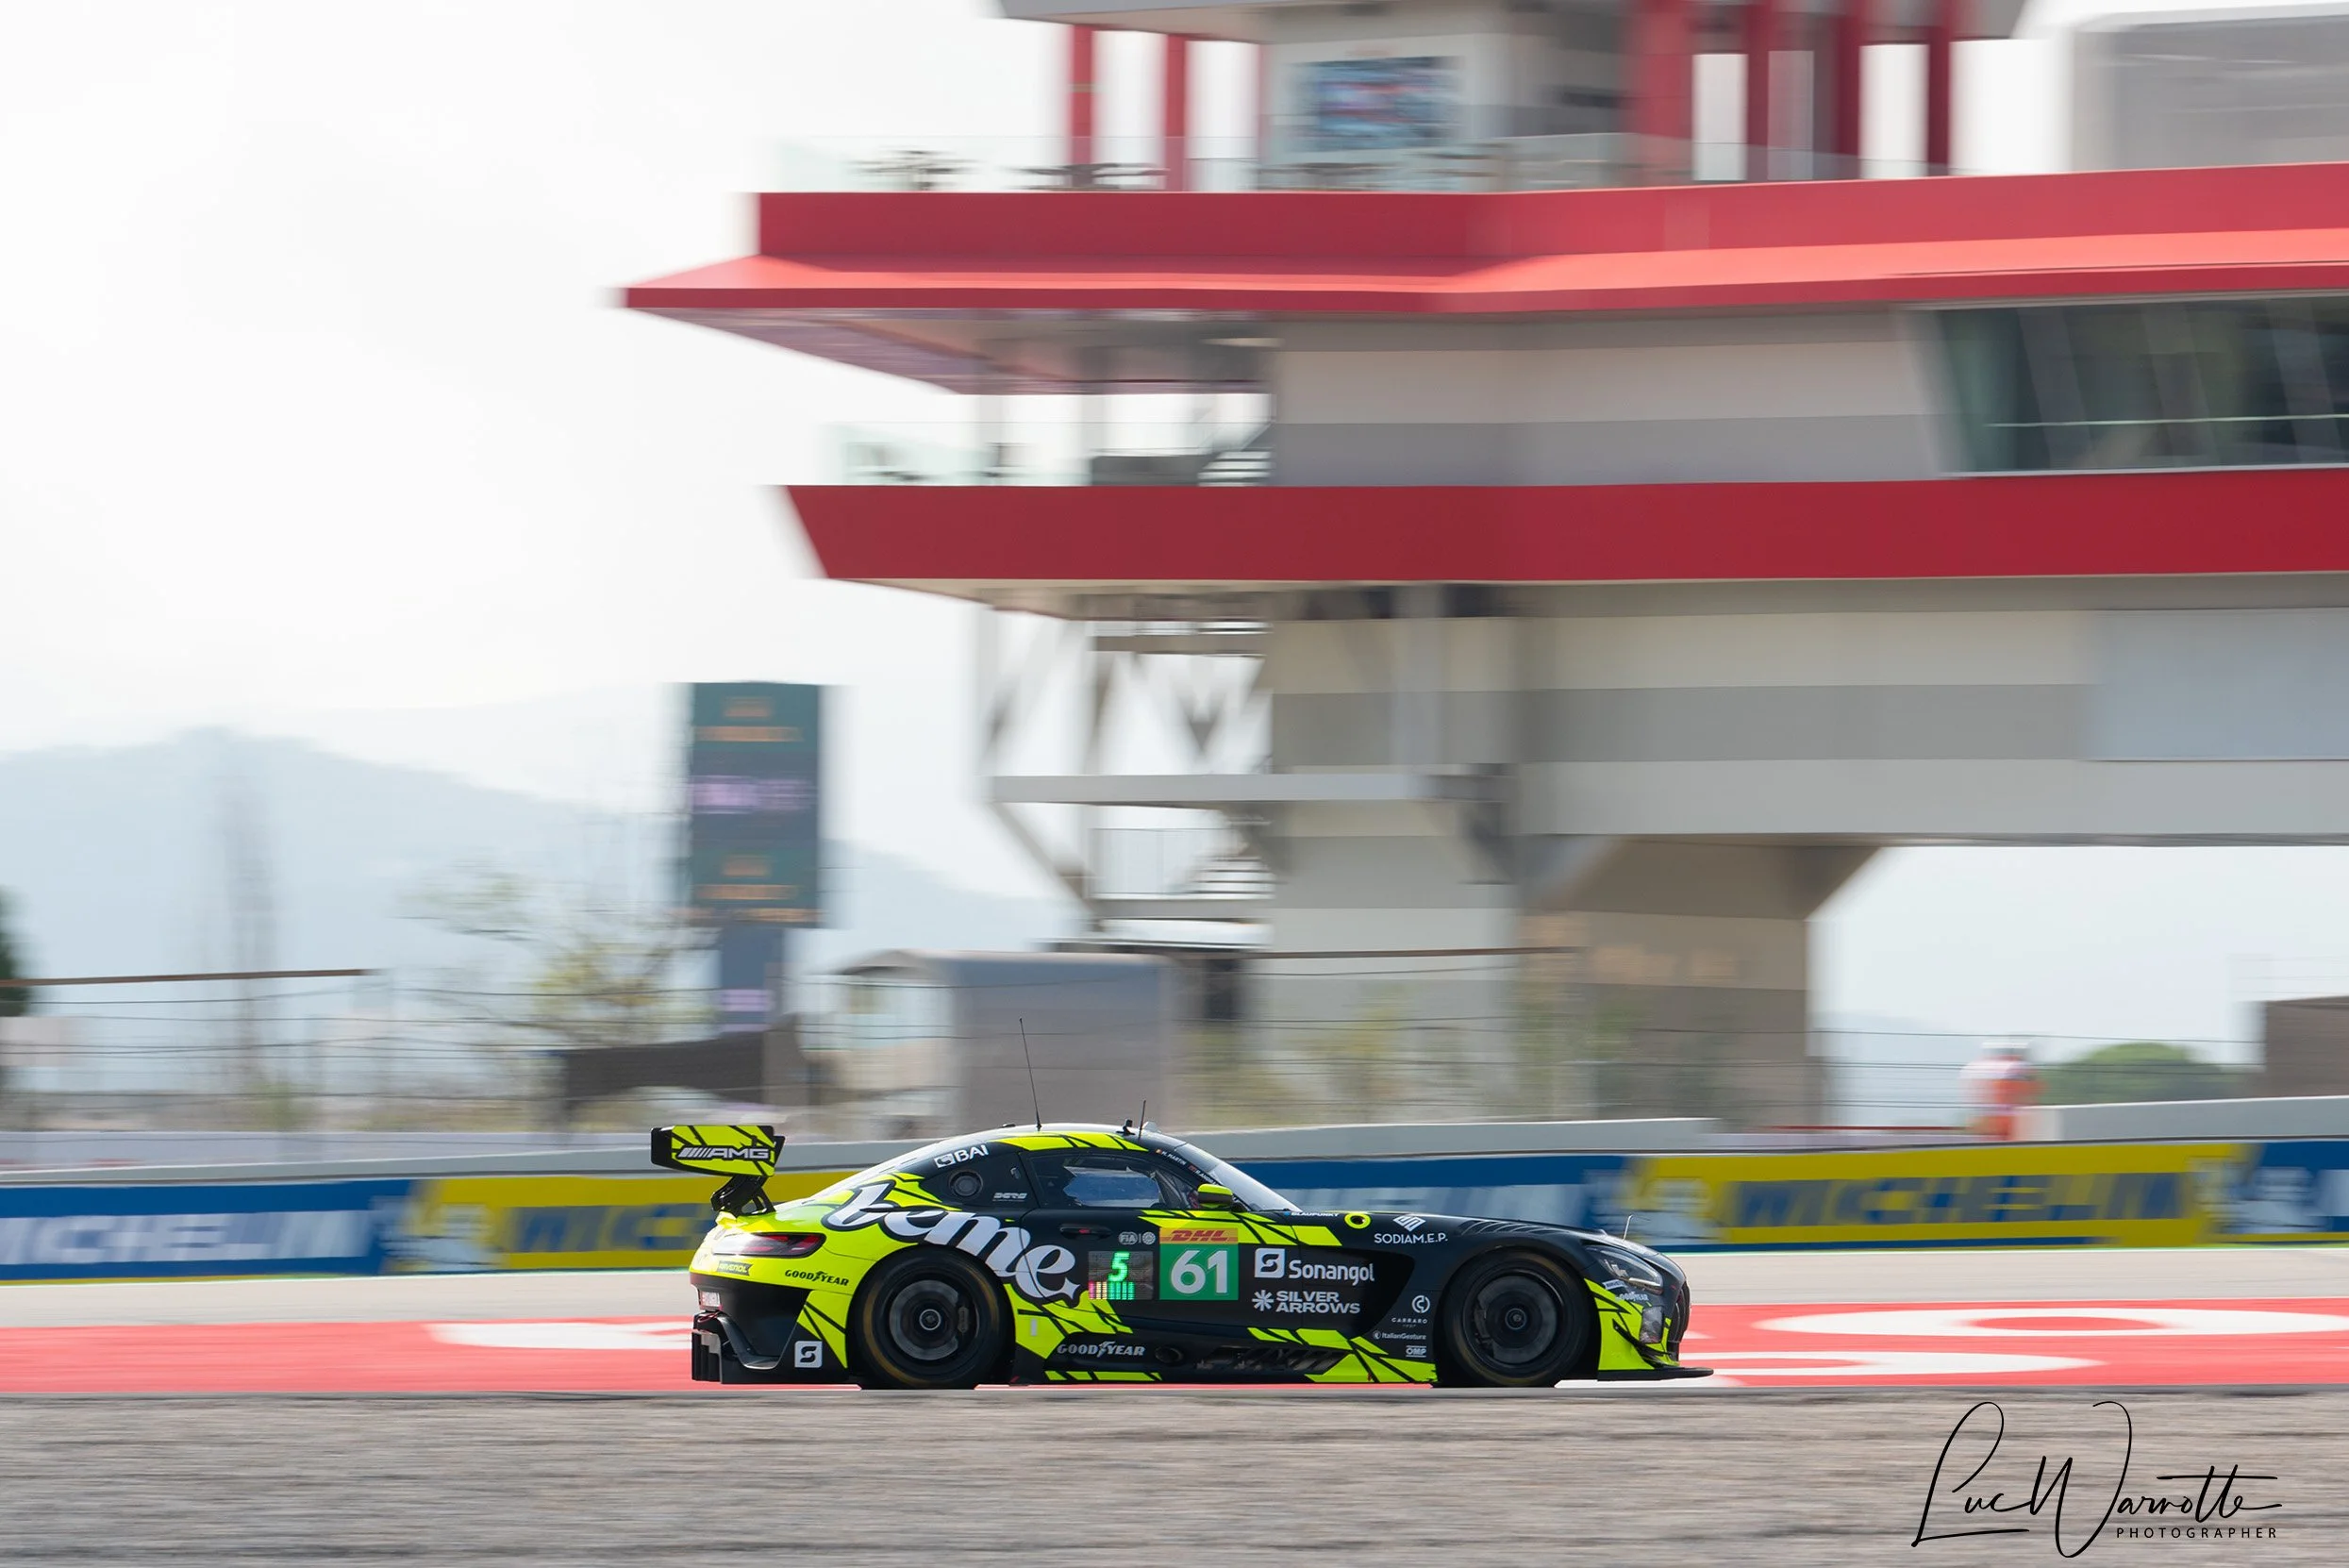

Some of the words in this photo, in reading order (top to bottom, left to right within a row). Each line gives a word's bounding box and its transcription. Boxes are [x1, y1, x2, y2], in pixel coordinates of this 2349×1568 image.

[954, 1144, 989, 1162] BAI
[1119, 1233, 1138, 1244] FIA
[1171, 1229, 1227, 1242] DHL
[1374, 1232, 1449, 1244] SODIAM.E.P.
[1108, 1251, 1131, 1282] 5
[1171, 1249, 1228, 1294] 61
[1289, 1259, 1375, 1286] Sonangol
[785, 1270, 849, 1287] GOODYEAR
[1275, 1291, 1340, 1303] SILVER
[1275, 1302, 1360, 1314] ARROWS
[1057, 1341, 1145, 1358] GOODYEAR
[1406, 1347, 1426, 1356] OMP
